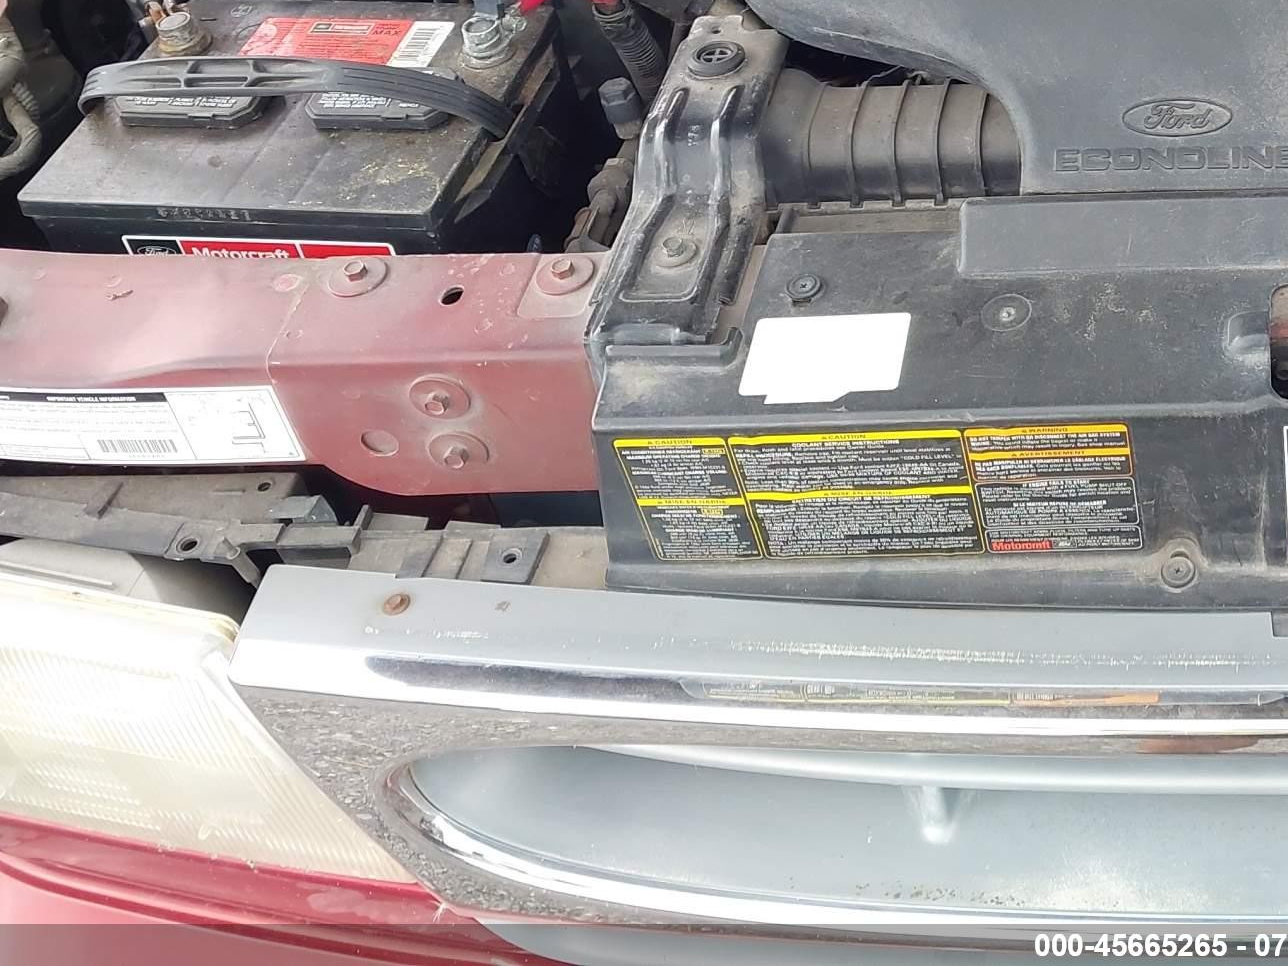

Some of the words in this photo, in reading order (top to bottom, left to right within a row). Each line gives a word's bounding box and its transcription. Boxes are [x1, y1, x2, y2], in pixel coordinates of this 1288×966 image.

[1144, 103, 1213, 130] Ford
[191, 246, 290, 260] Motorcraft
[991, 541, 1051, 551] Motorcraft
